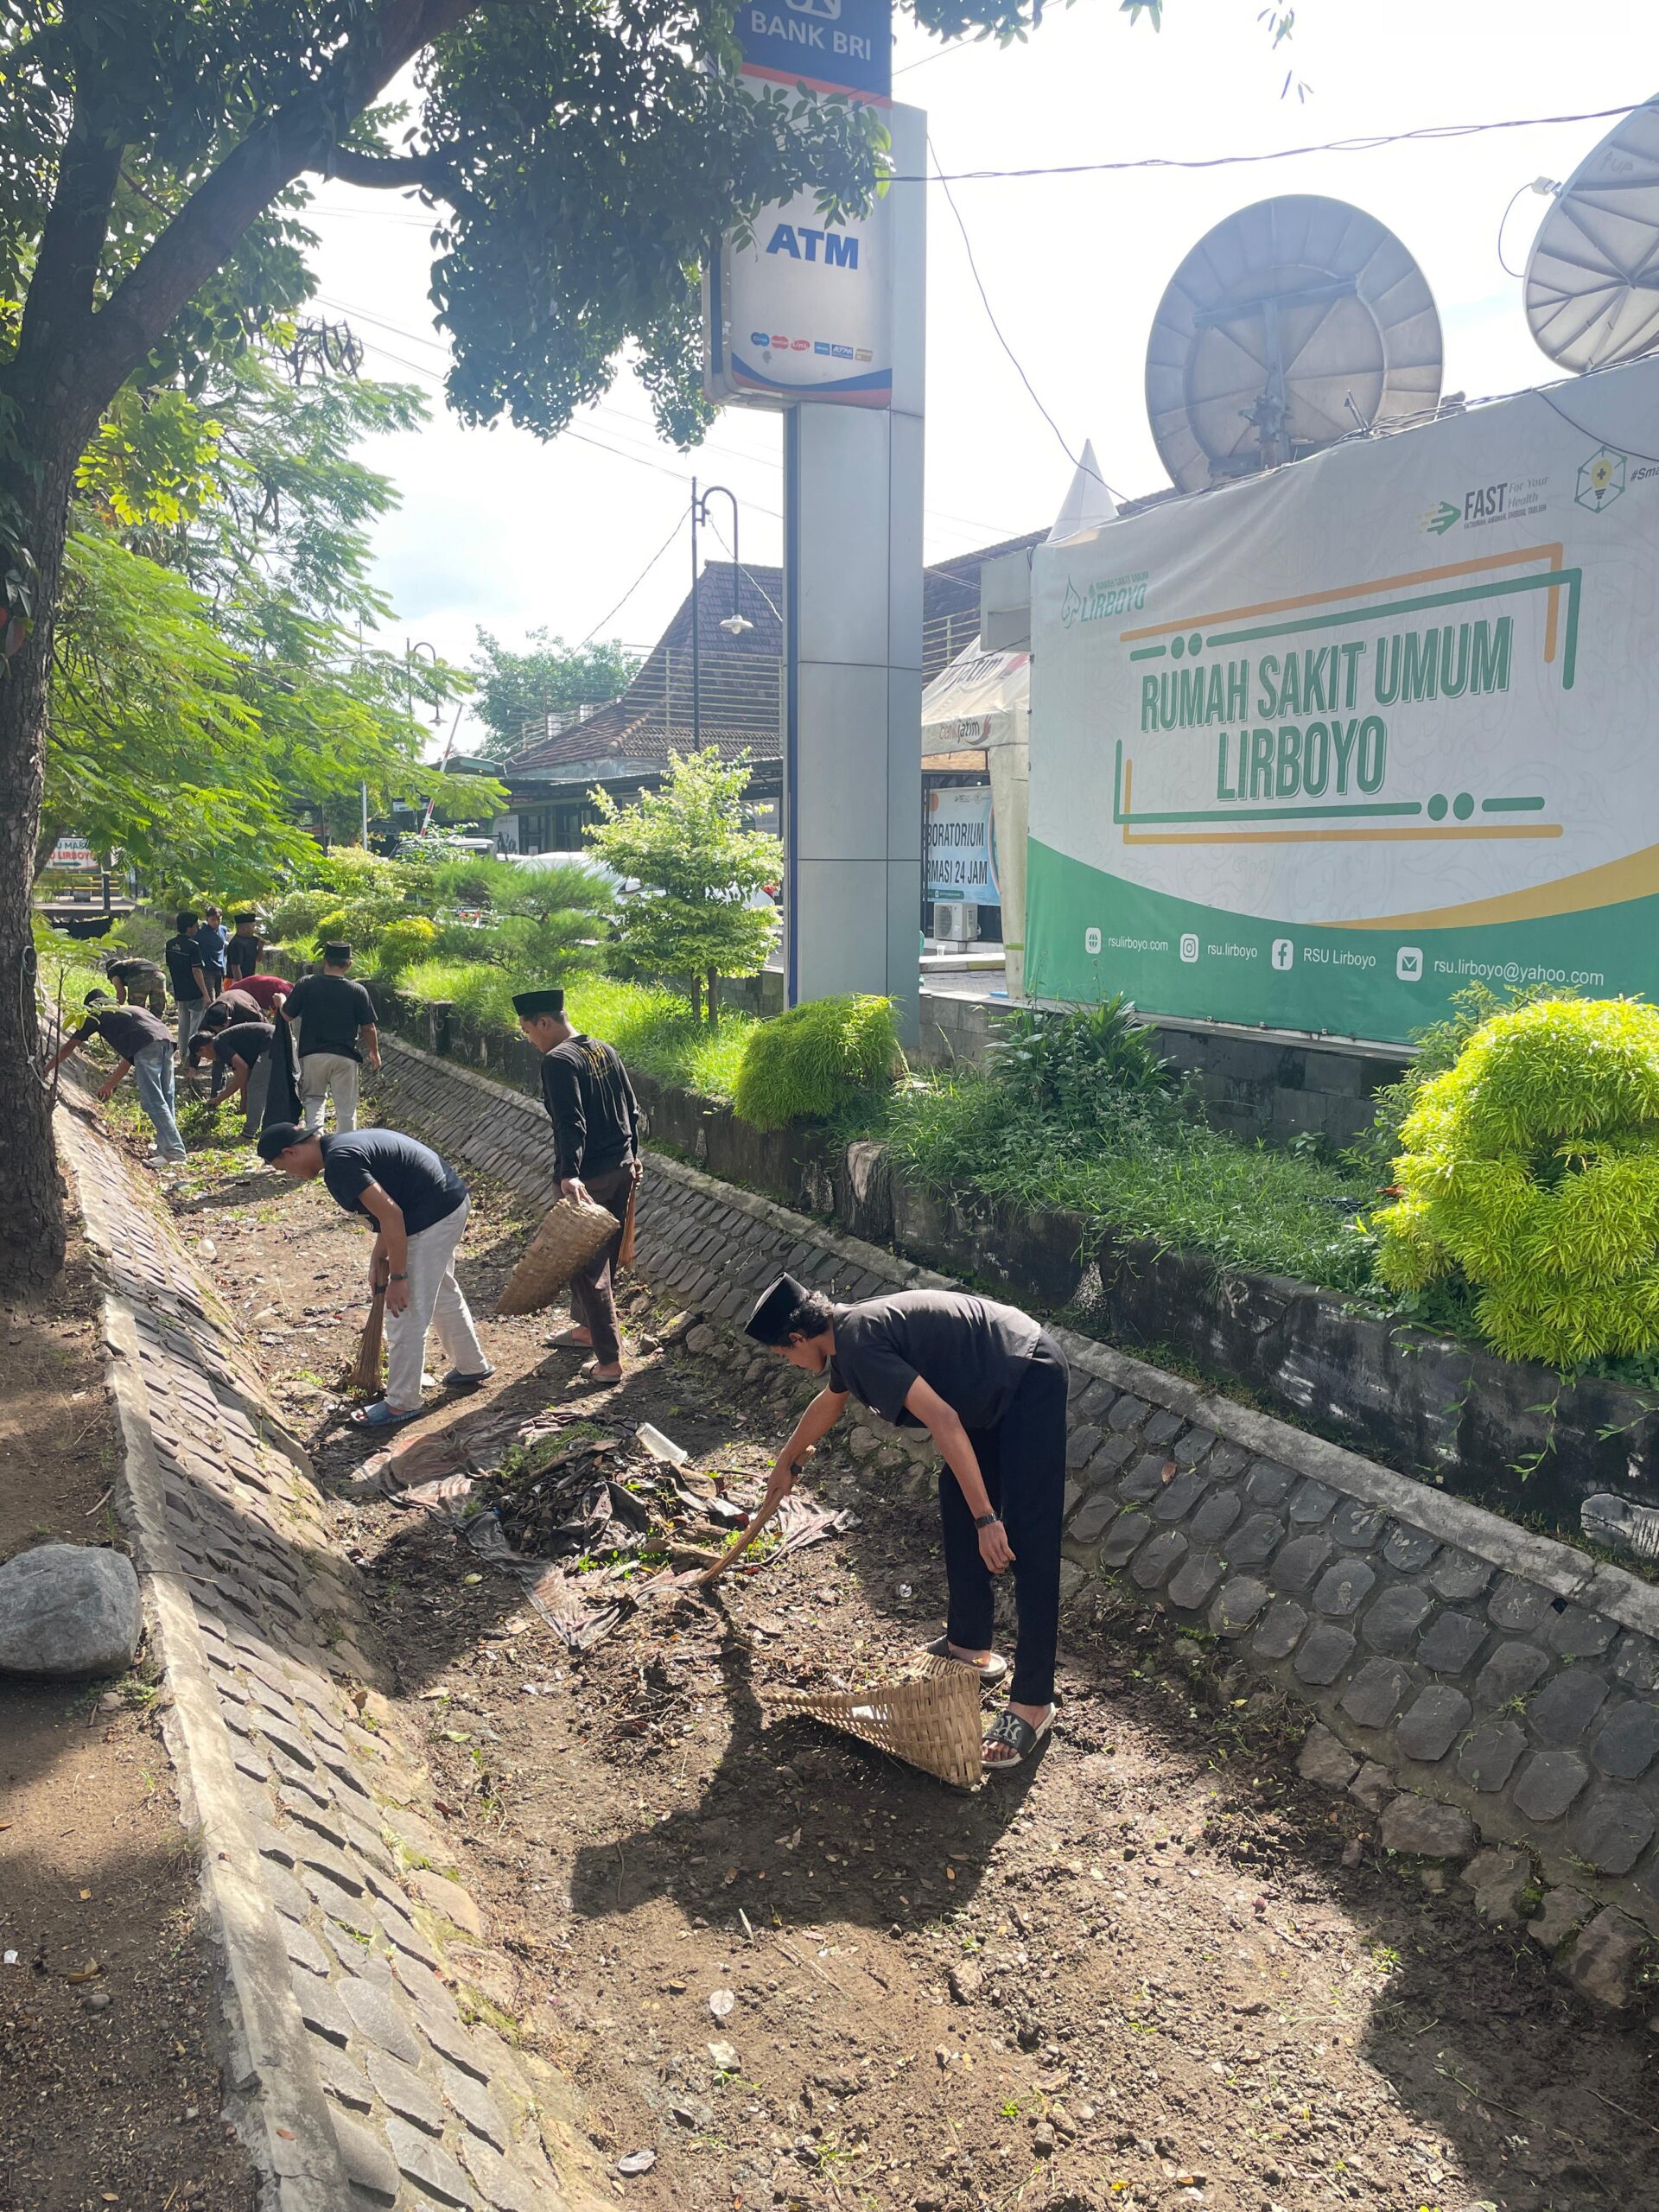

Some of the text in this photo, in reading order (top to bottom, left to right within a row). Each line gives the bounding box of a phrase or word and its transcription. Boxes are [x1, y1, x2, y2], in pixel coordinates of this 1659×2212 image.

[751, 10, 871, 60] BANK BRI
[766, 223, 859, 270] ATM
[1509, 476, 1549, 493] For Your
[1465, 482, 1508, 521] FAST
[1508, 492, 1539, 509] Health
[1081, 582, 1147, 622] LIRBOYO
[1141, 616, 1514, 733] RUMAH SAKIT UMUM
[1217, 715, 1388, 801] LIRBOYO
[927, 822, 984, 847] BORATORIUM
[927, 860, 988, 885] RMASI 24 JAM
[1108, 936, 1168, 952] rsulirboyo.com
[1207, 943, 1258, 960] rsu.lirboyo
[1303, 948, 1376, 970] RSU Lirboyo
[1434, 959, 1605, 986] rsu.lirboyo@yahoo.com
